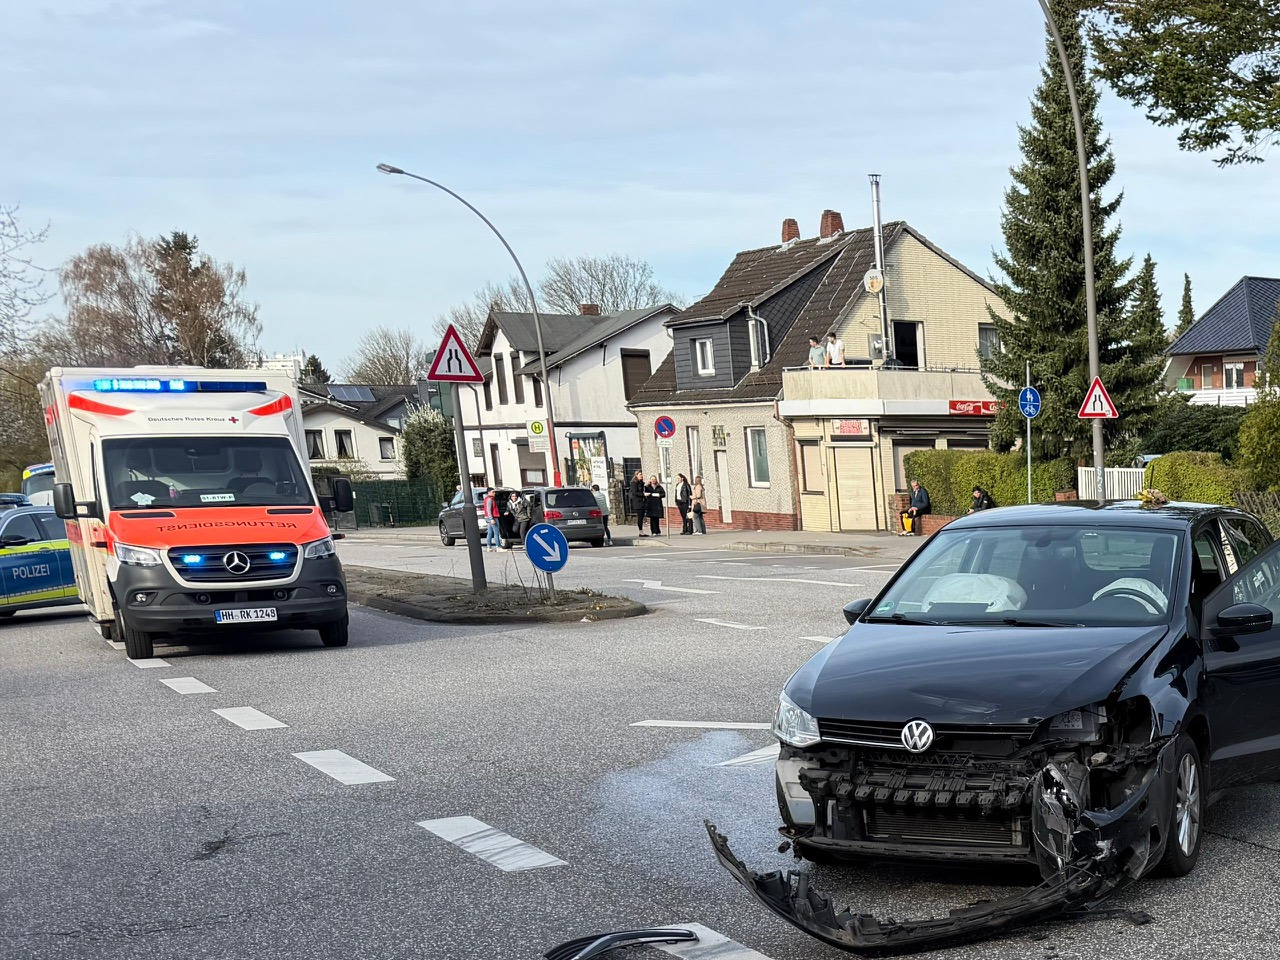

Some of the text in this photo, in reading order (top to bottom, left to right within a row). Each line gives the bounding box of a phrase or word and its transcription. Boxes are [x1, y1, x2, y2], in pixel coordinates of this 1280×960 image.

[12, 563, 51, 580] POLIZEI
[221, 610, 235, 621] HH
[240, 610, 252, 620] RK
